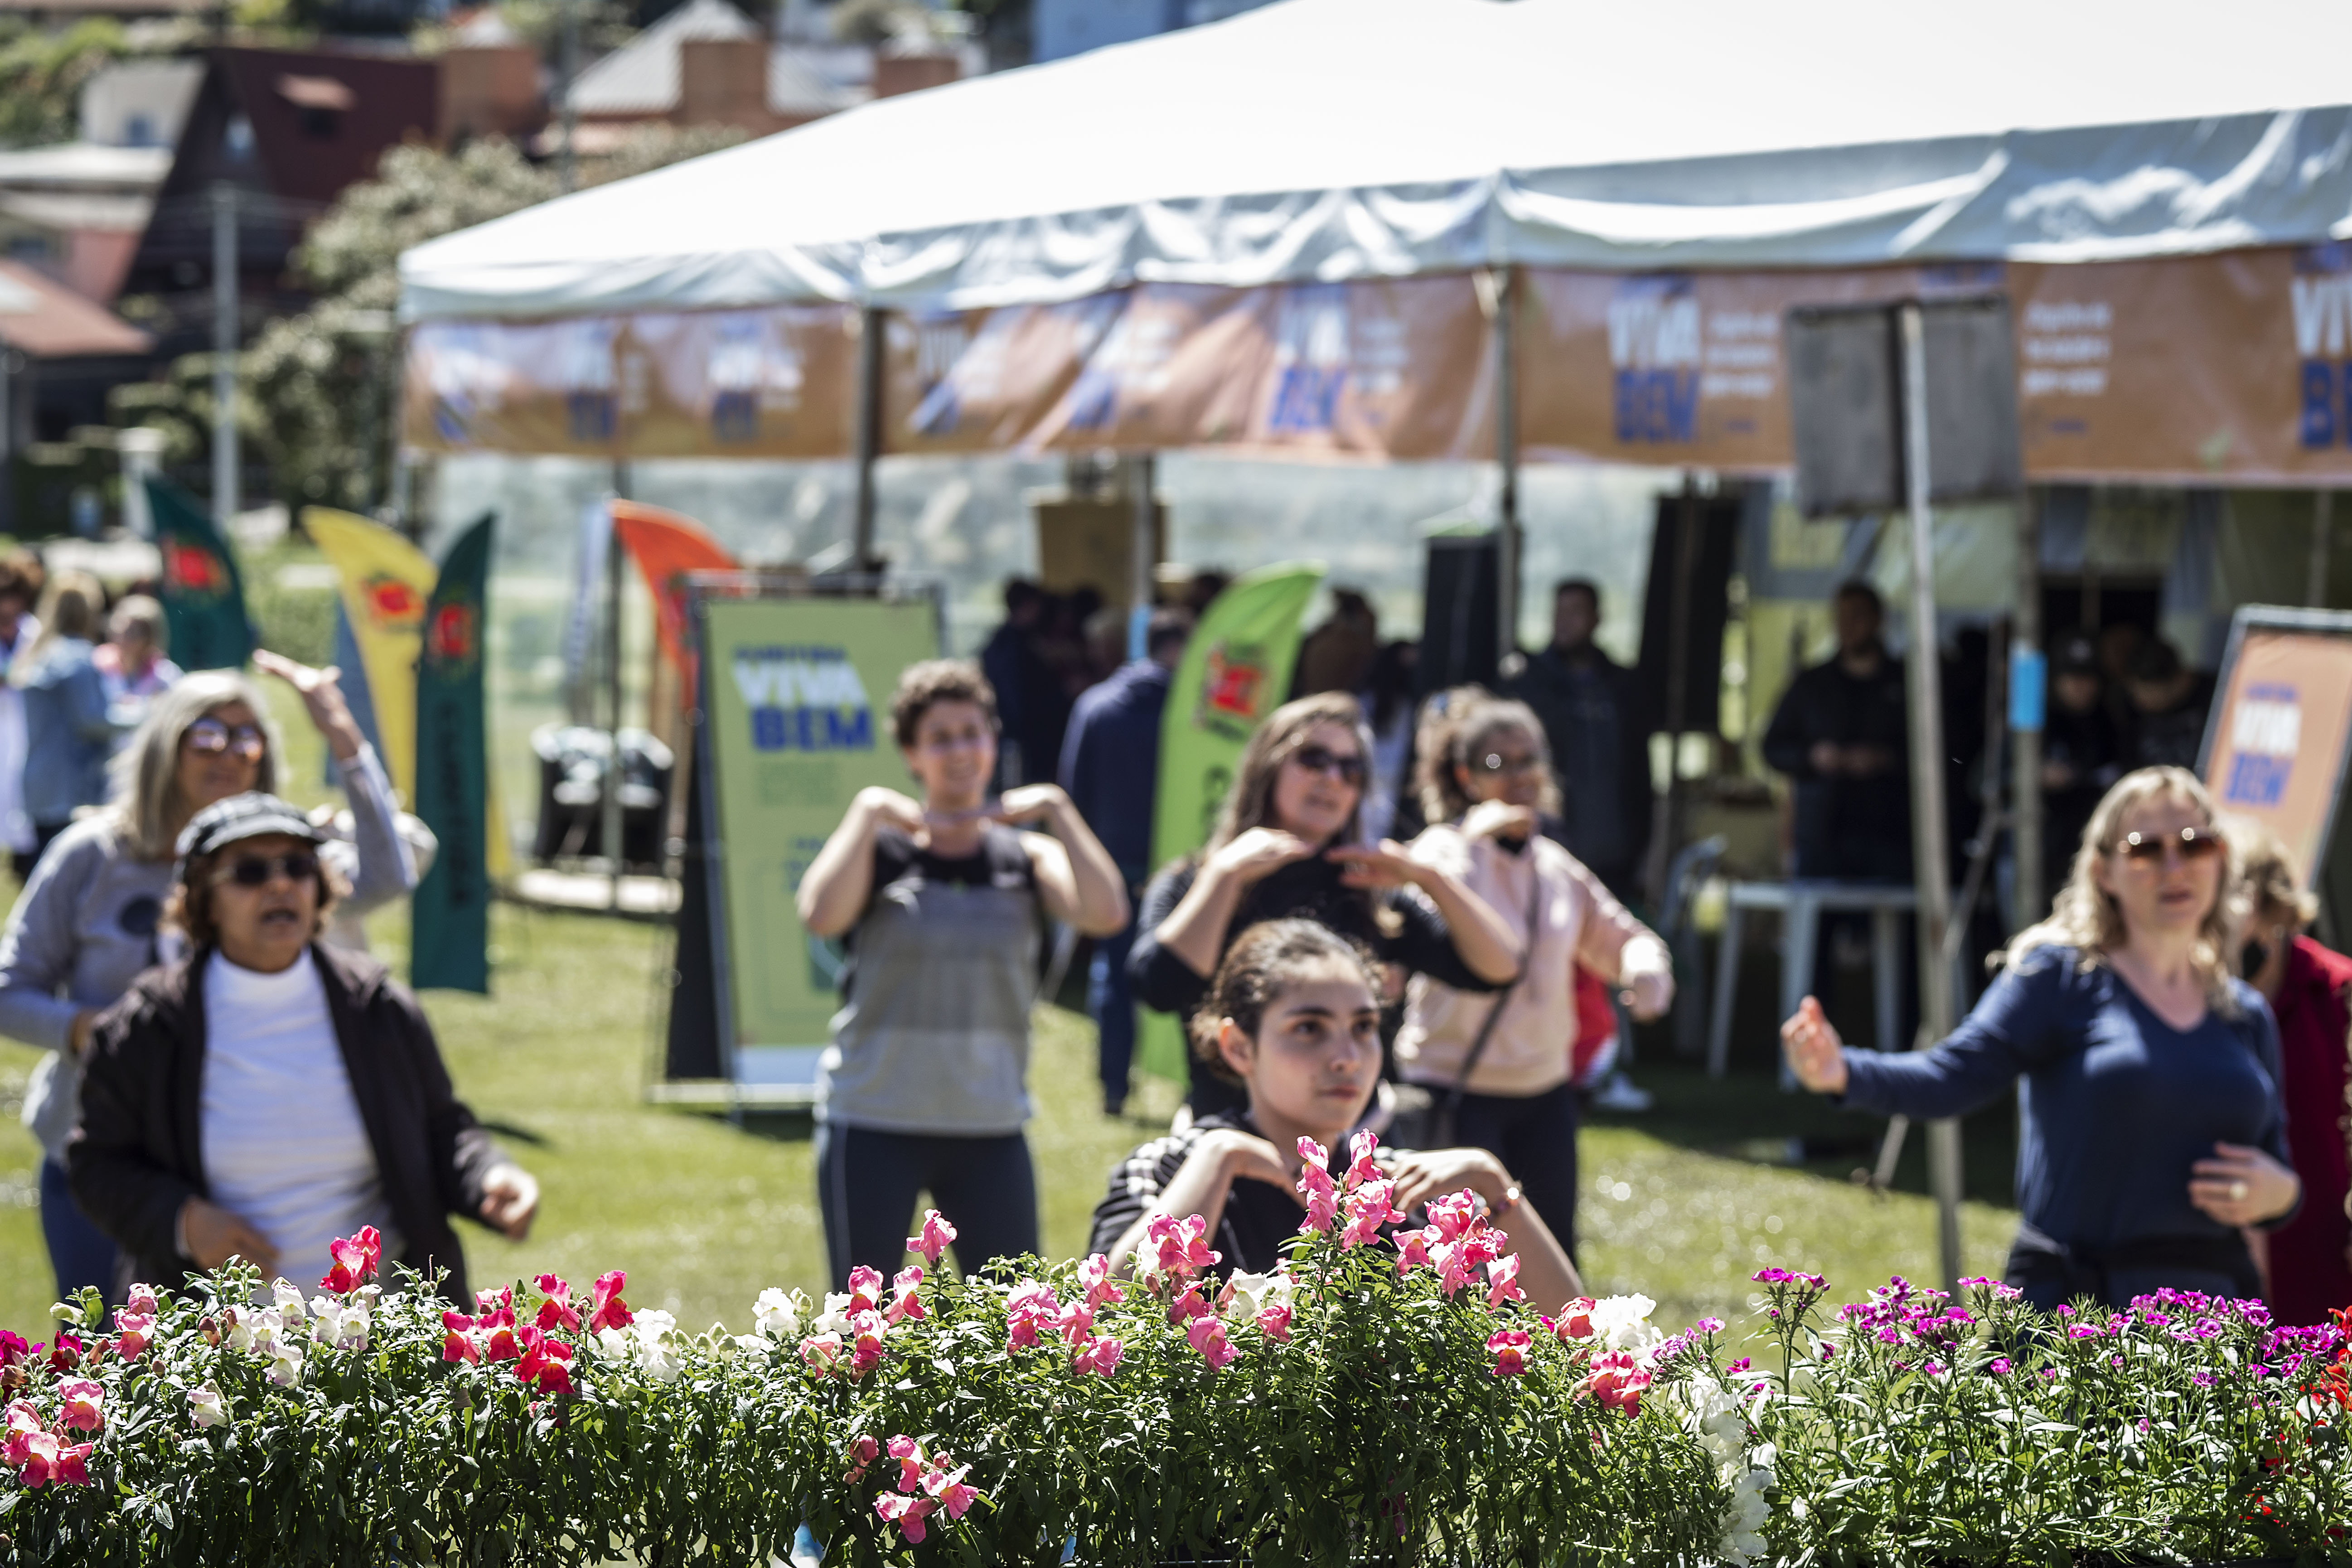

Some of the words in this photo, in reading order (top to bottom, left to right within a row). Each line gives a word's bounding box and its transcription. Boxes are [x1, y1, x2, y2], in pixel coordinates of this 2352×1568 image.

[1609, 297, 1700, 369] VIVA
[2291, 275, 2352, 357] VI
[1615, 368, 1699, 445] BEM
[2300, 360, 2352, 449] B
[731, 659, 869, 707] VIVA
[749, 705, 876, 751] BEM
[2231, 702, 2302, 757] VIVA
[2226, 750, 2295, 809] BEM
